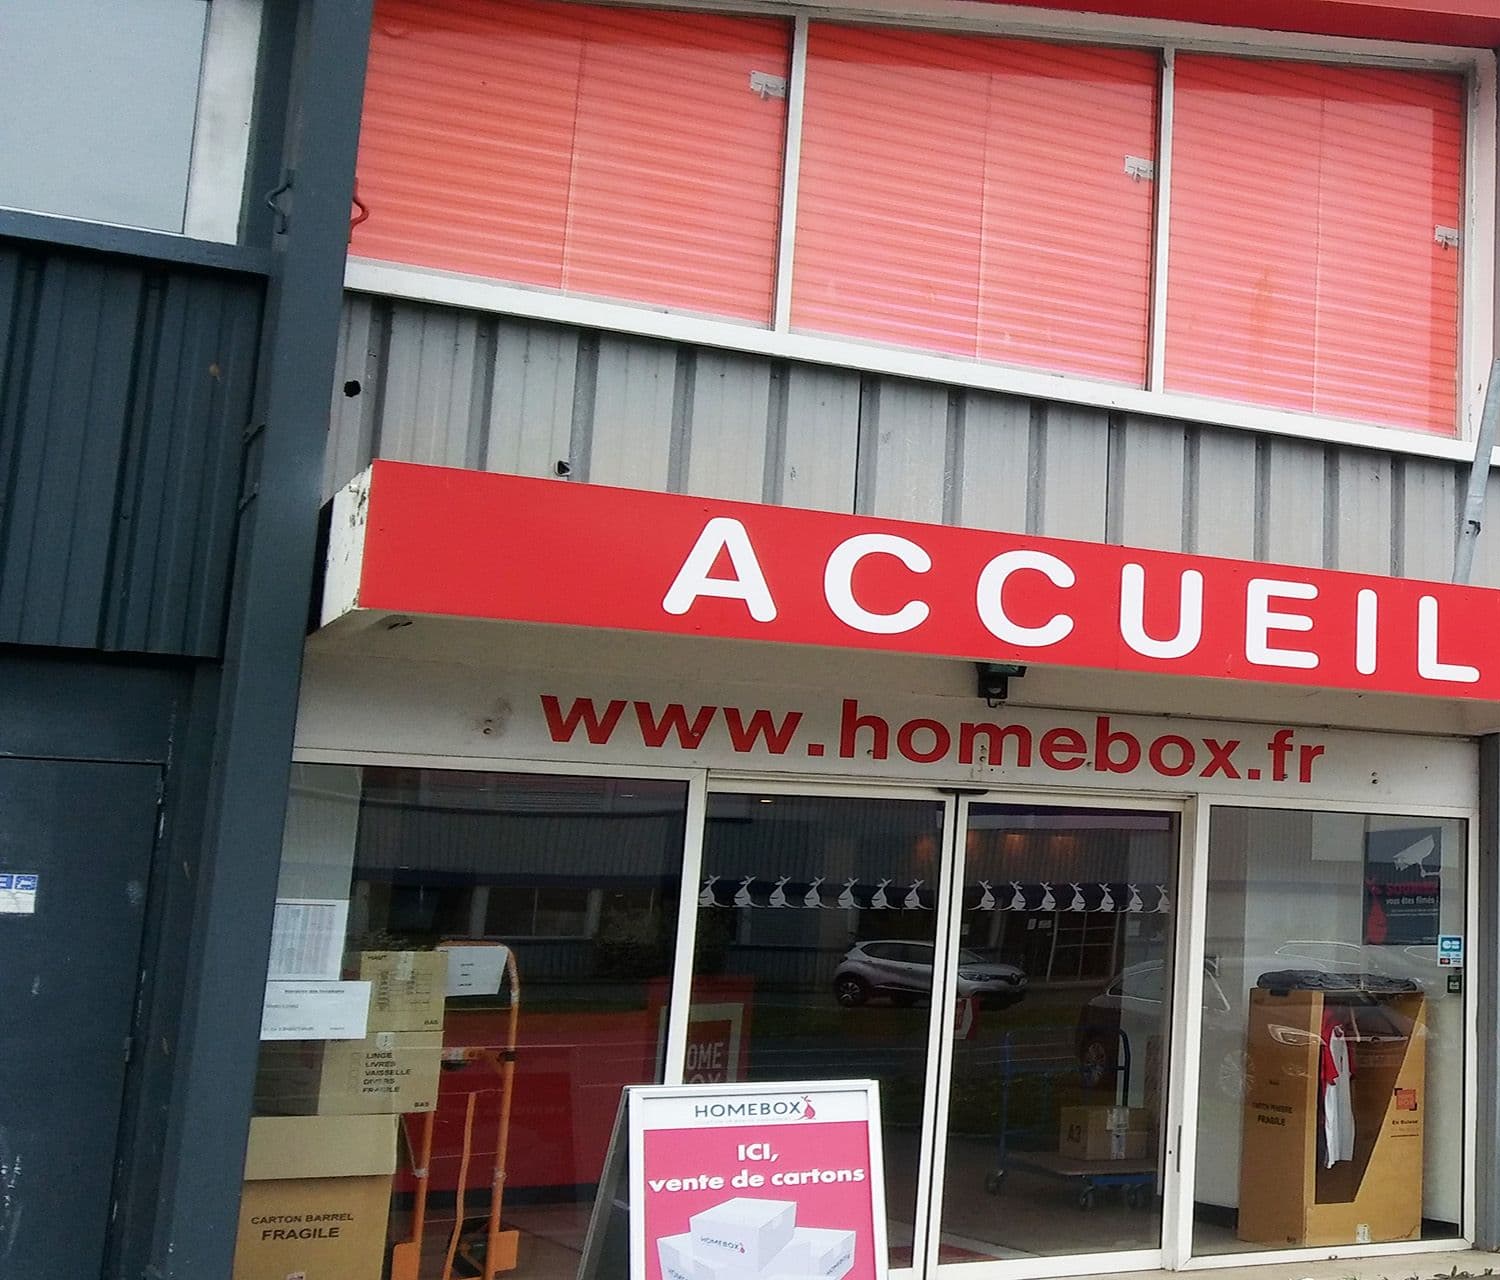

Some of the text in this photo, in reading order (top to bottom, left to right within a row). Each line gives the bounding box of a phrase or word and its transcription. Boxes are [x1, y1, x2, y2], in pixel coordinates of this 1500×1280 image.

[661, 516, 1481, 684] ACCUEIL
[540, 694, 1327, 785] www.homebox.fr
[366, 1052, 393, 1060] LINGE
[687, 1042, 724, 1070] OME
[362, 1086, 401, 1094] FRALE
[694, 1101, 801, 1119] HOMEBOX
[1257, 1114, 1286, 1127] FRAGILE
[736, 1143, 779, 1163] ICI,
[648, 1168, 865, 1193] vente de cartons
[250, 1212, 355, 1225] CARTON BARREL
[261, 1226, 341, 1241] FRAGILE
[700, 1236, 740, 1250] HOMEBOX
